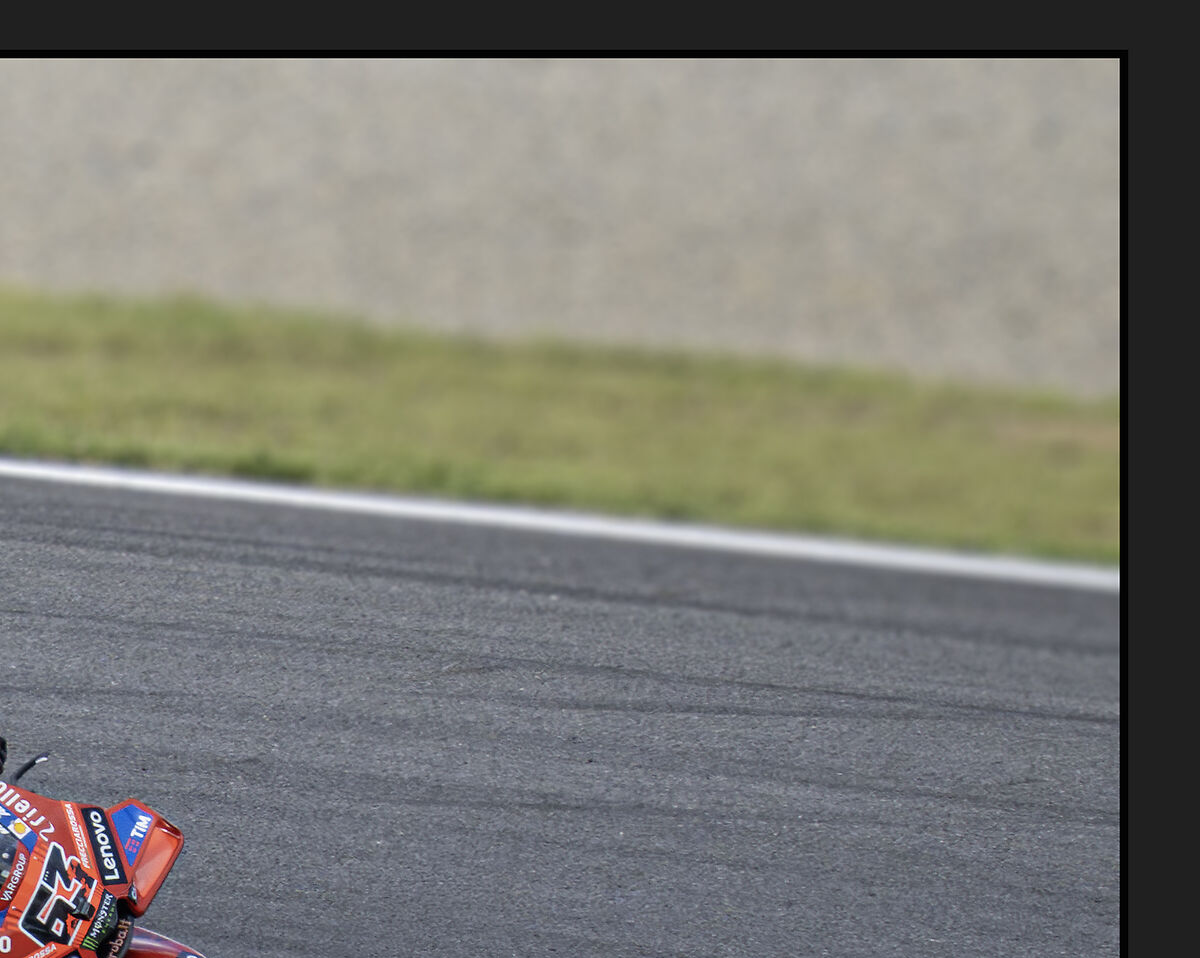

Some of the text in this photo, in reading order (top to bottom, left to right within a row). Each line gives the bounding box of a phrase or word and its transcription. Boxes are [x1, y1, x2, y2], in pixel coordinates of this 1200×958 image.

[90, 811, 120, 881] Lenovo
[130, 814, 151, 839] TIM
[0, 853, 28, 902] VARGROUP
[18, 841, 98, 948] 63
[90, 893, 113, 938] MONSTER
